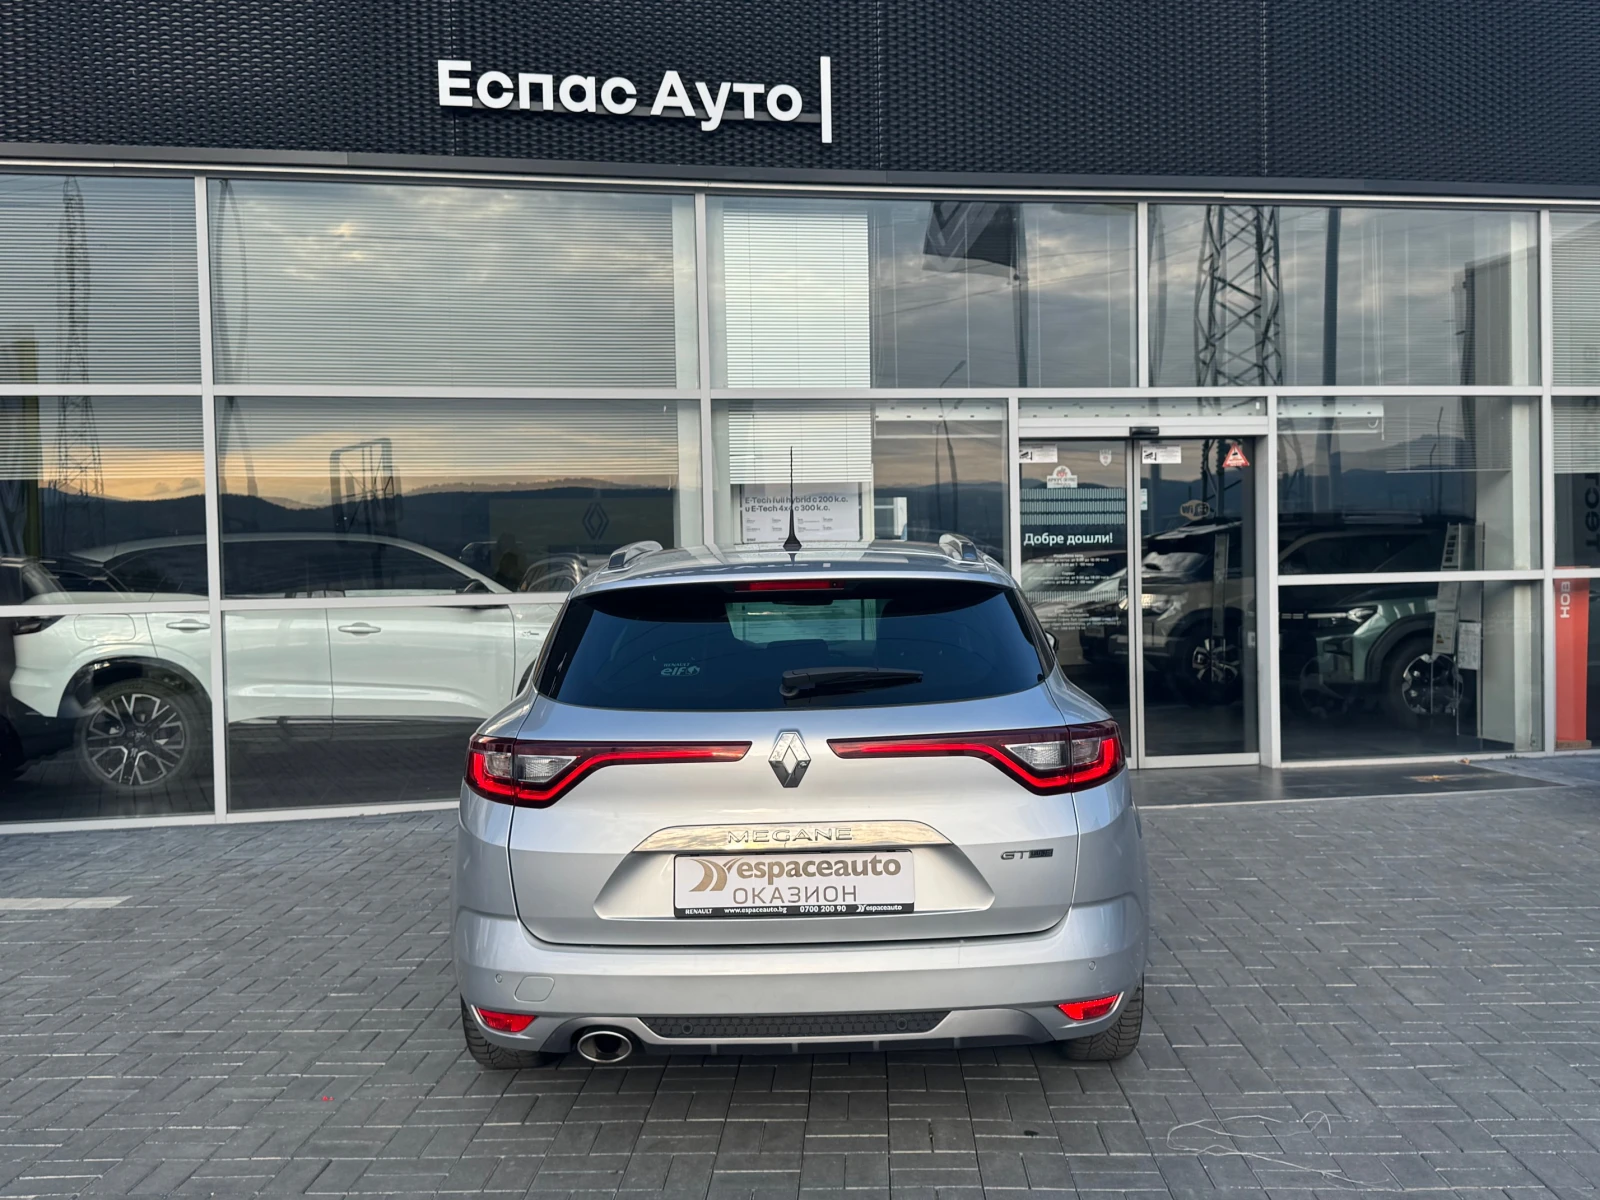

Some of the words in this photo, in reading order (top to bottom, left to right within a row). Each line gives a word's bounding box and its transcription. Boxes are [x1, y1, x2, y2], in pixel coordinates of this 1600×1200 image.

[437, 59, 638, 115] Еспас
[650, 70, 803, 132] Ауто
[751, 504, 777, 512] E-Tech
[1023, 533, 1064, 547] Добре
[1066, 532, 1113, 546] дошли!
[727, 827, 853, 844] MEGANE
[1000, 850, 1029, 860] GT
[736, 855, 901, 885] espaceauto
[732, 885, 857, 905] ОКАЗИОН
[723, 906, 788, 914] www.espaceauto.bg
[799, 905, 818, 913] 0700
[836, 904, 847, 912] 90
[865, 904, 903, 912] espaceauto
